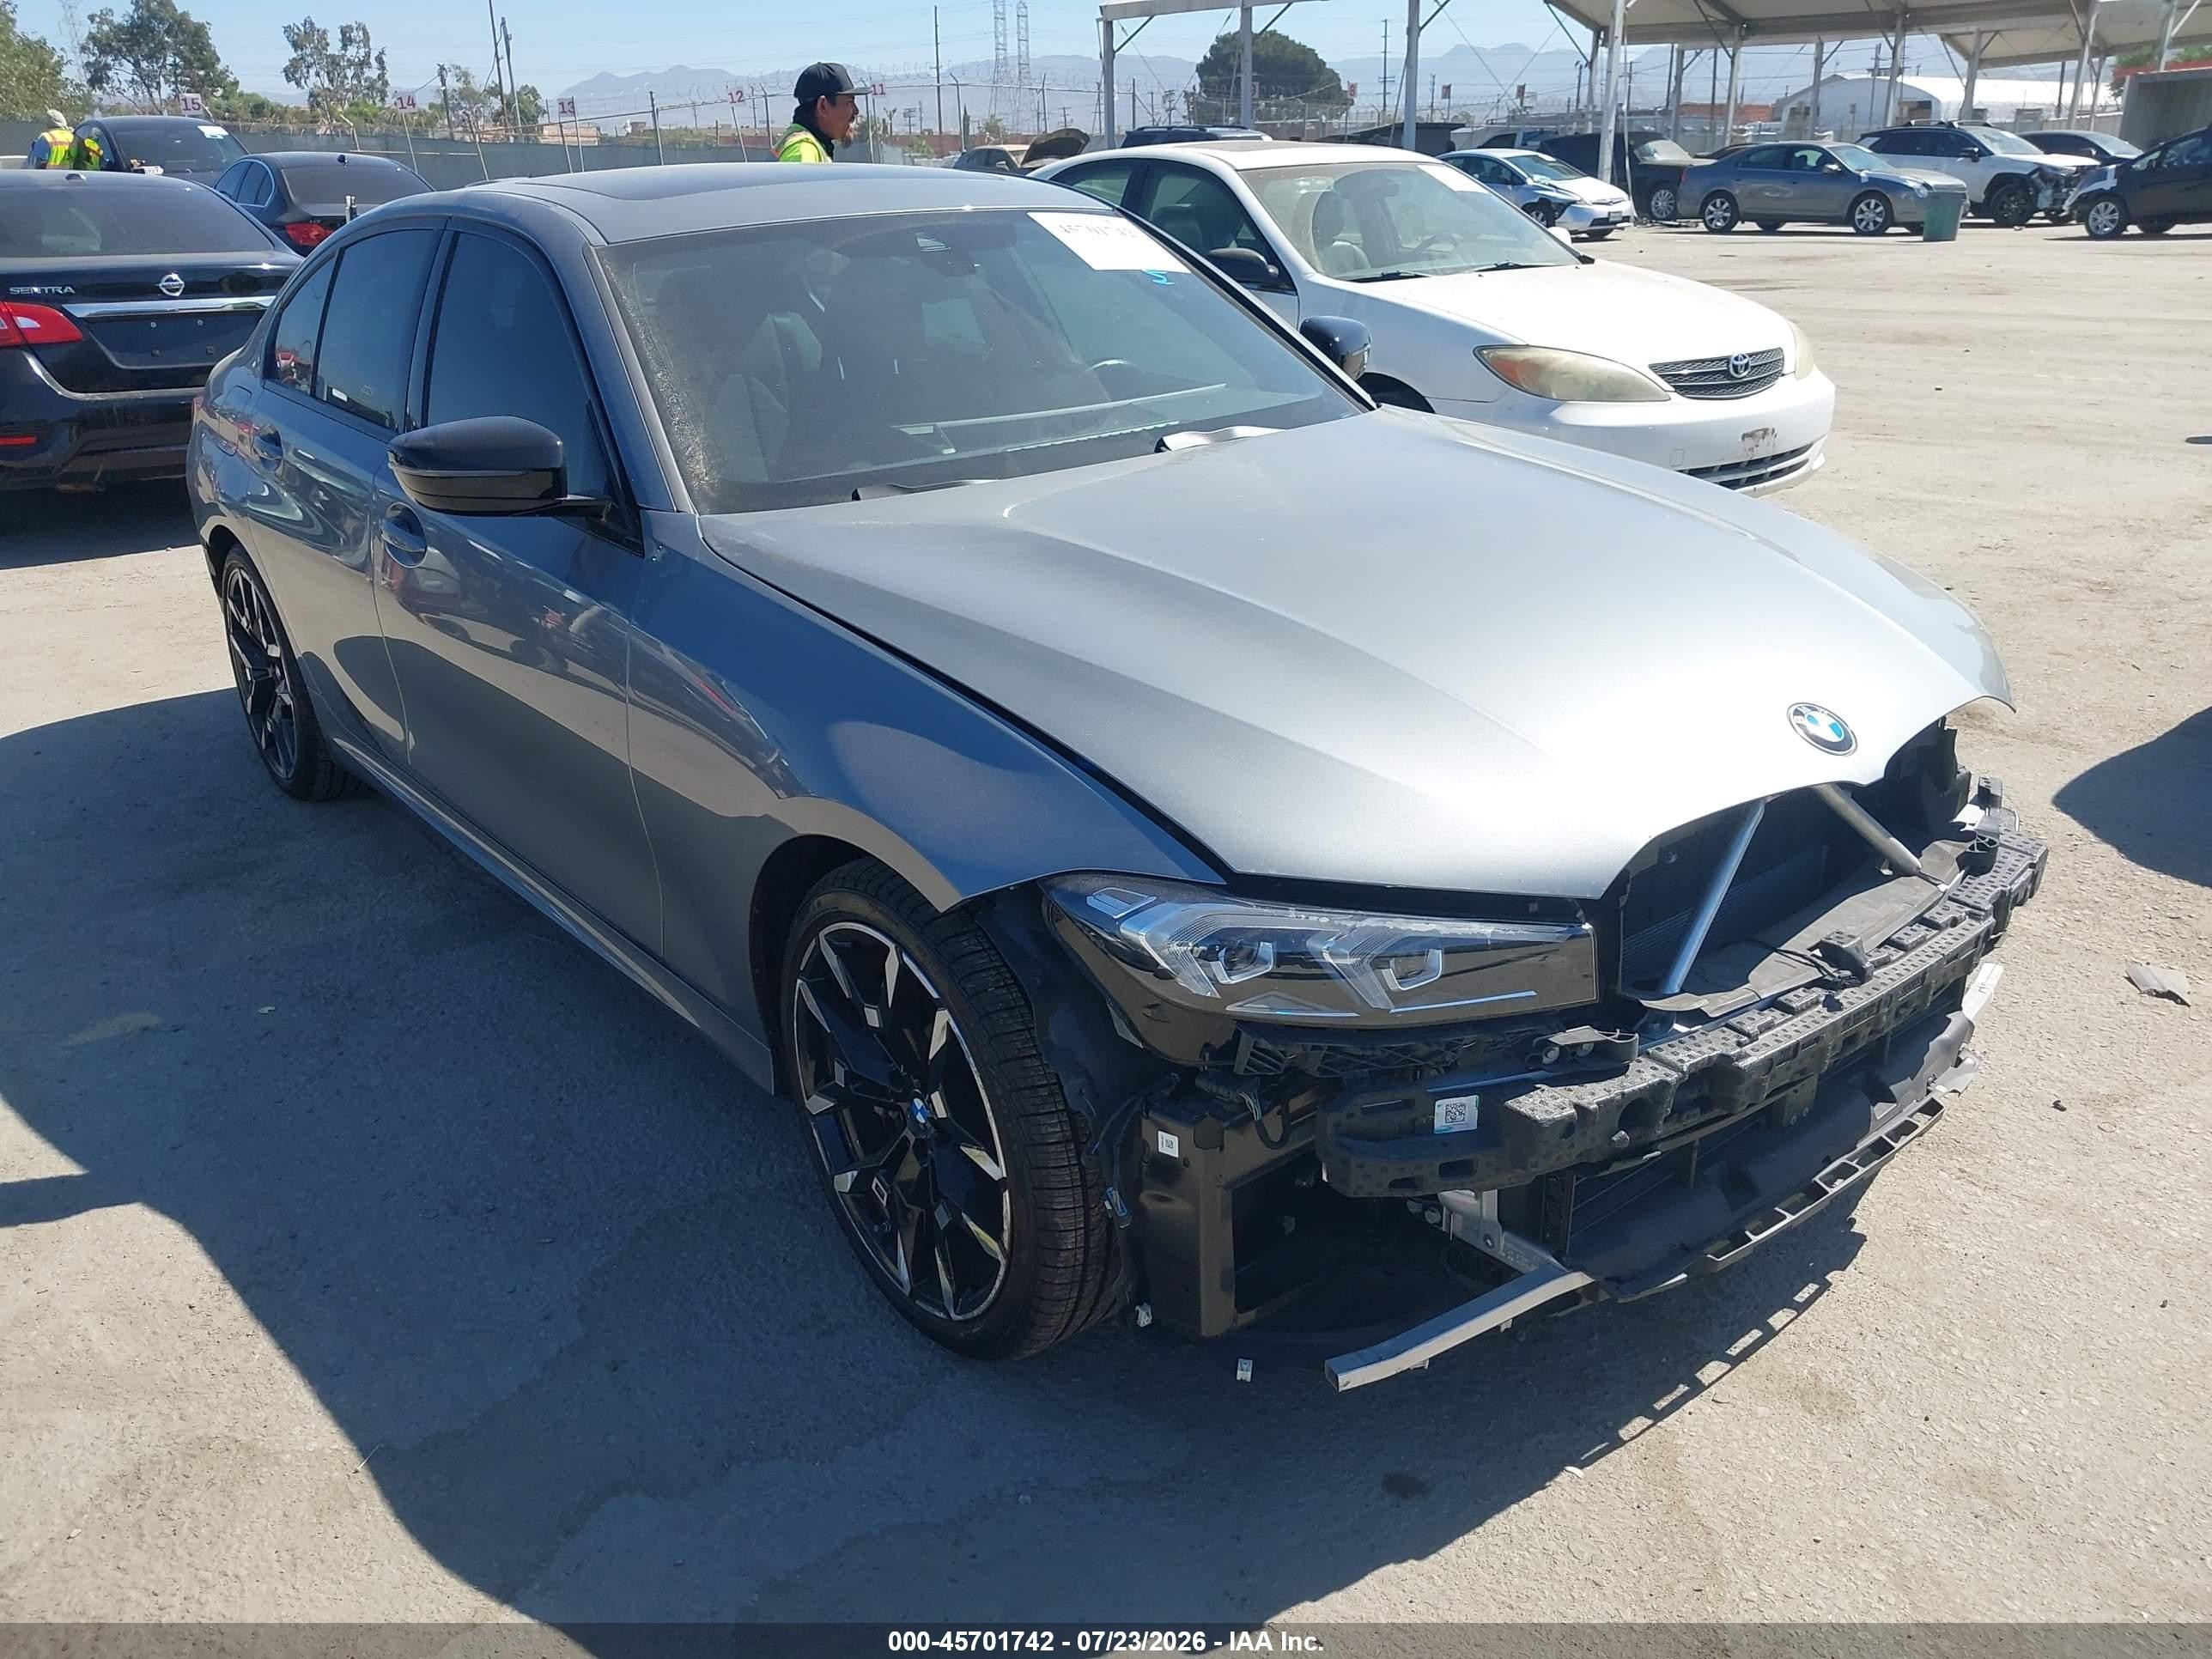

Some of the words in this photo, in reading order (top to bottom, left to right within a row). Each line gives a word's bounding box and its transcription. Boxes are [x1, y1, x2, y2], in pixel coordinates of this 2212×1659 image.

[870, 83, 886, 95] 11
[1349, 84, 1356, 96] 8
[397, 95, 416, 109] 14
[728, 90, 744, 103] 12
[181, 97, 201, 111] 15
[559, 101, 575, 113] 13
[9, 286, 76, 295] SENTRA
